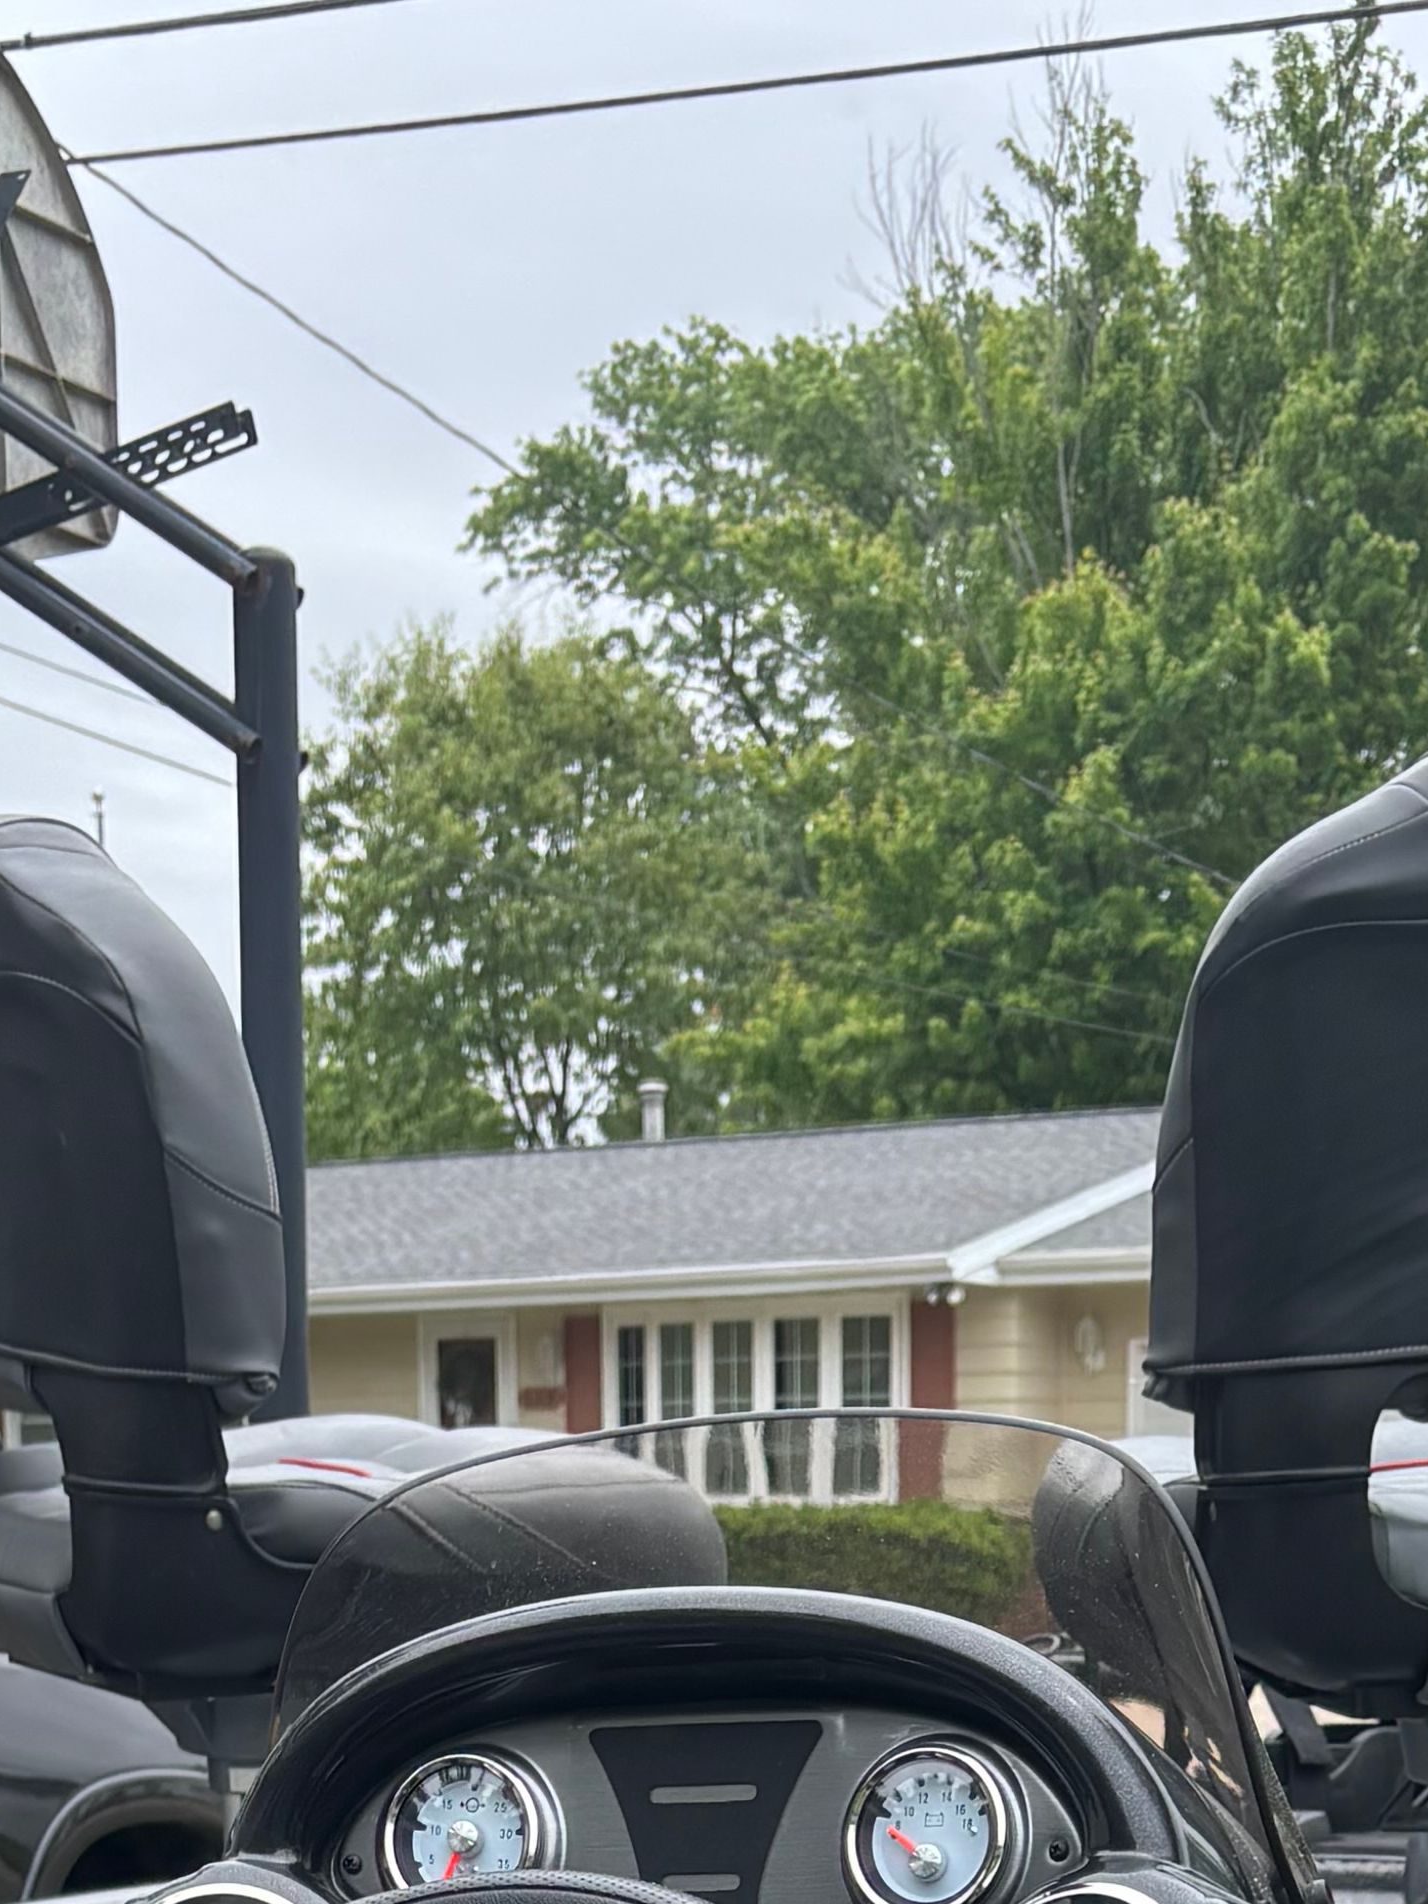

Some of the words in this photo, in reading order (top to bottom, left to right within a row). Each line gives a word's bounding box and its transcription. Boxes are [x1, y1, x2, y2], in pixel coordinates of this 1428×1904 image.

[918, 1792, 929, 1804] 12
[942, 1792, 953, 1802] 14
[442, 1799, 453, 1810] 15
[493, 1801, 507, 1813] 25
[955, 1804, 966, 1815] 16
[904, 1806, 915, 1817] 10
[430, 1825, 442, 1836] 10
[499, 1828, 513, 1840] 30
[428, 1853, 435, 1865] 5
